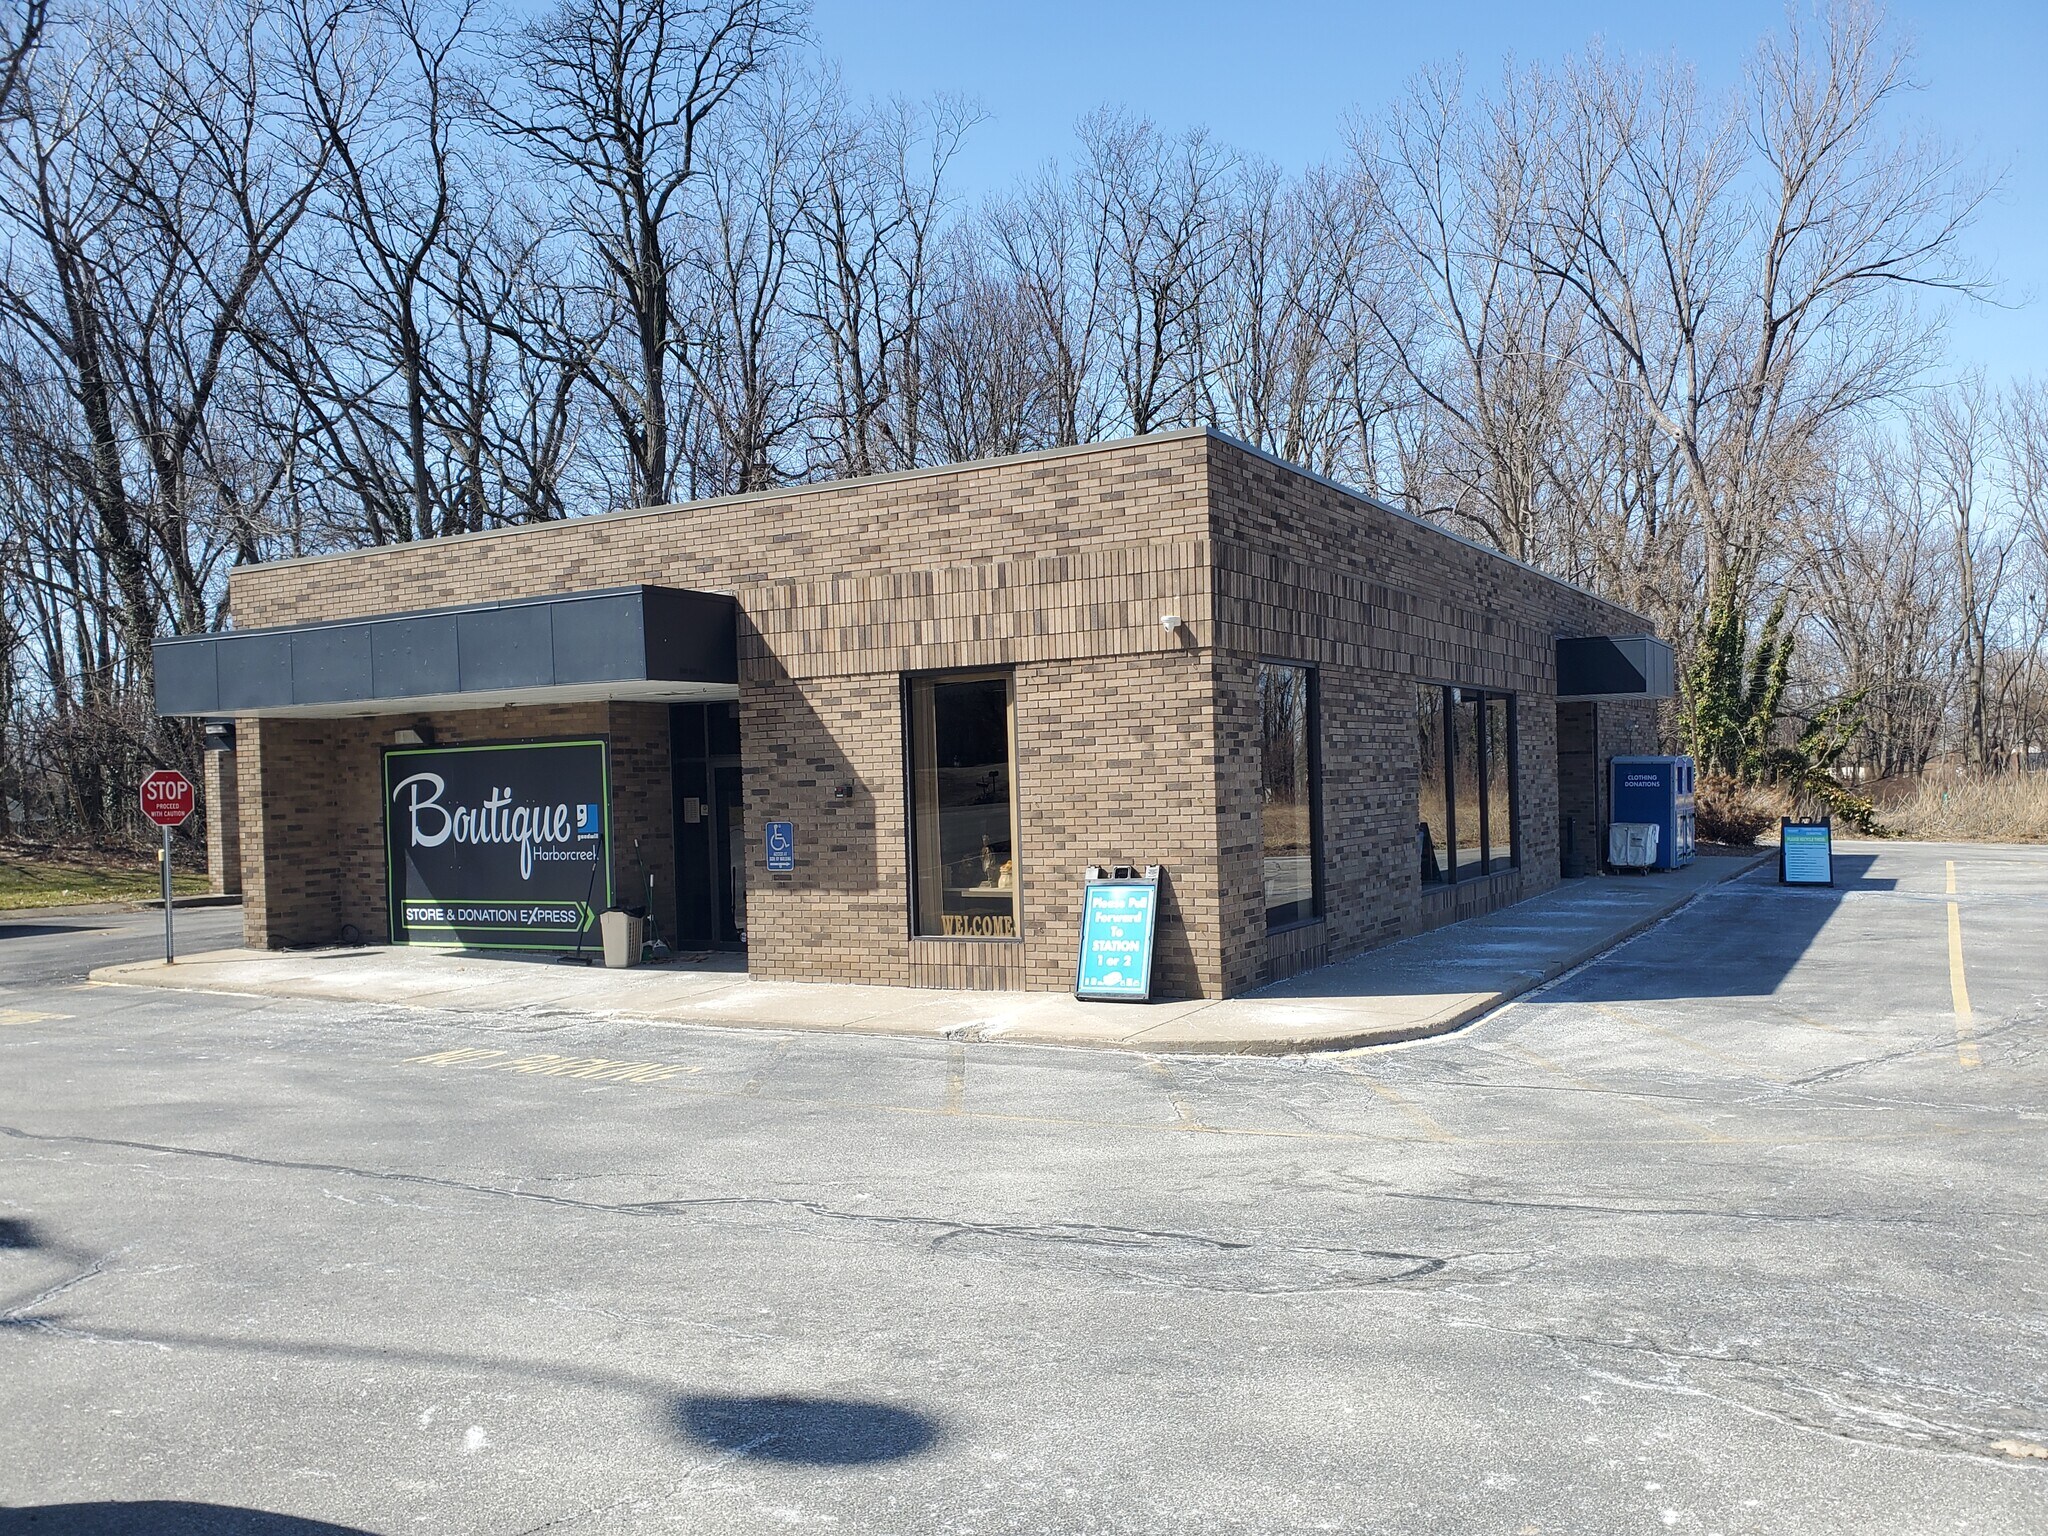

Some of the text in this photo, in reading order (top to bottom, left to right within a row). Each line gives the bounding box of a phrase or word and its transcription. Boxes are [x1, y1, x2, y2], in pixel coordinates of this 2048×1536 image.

[147, 781, 188, 800] STOP
[393, 772, 571, 880] Boutique
[406, 907, 576, 925] STORE & DONATION EXPRESS
[1094, 911, 1142, 923] Forward
[941, 915, 1013, 936] WELCOME
[1110, 925, 1124, 938] To
[1091, 940, 1140, 952] STATION
[1097, 954, 1132, 967] 1 or 2
[402, 1048, 703, 1082] NO PARKING
